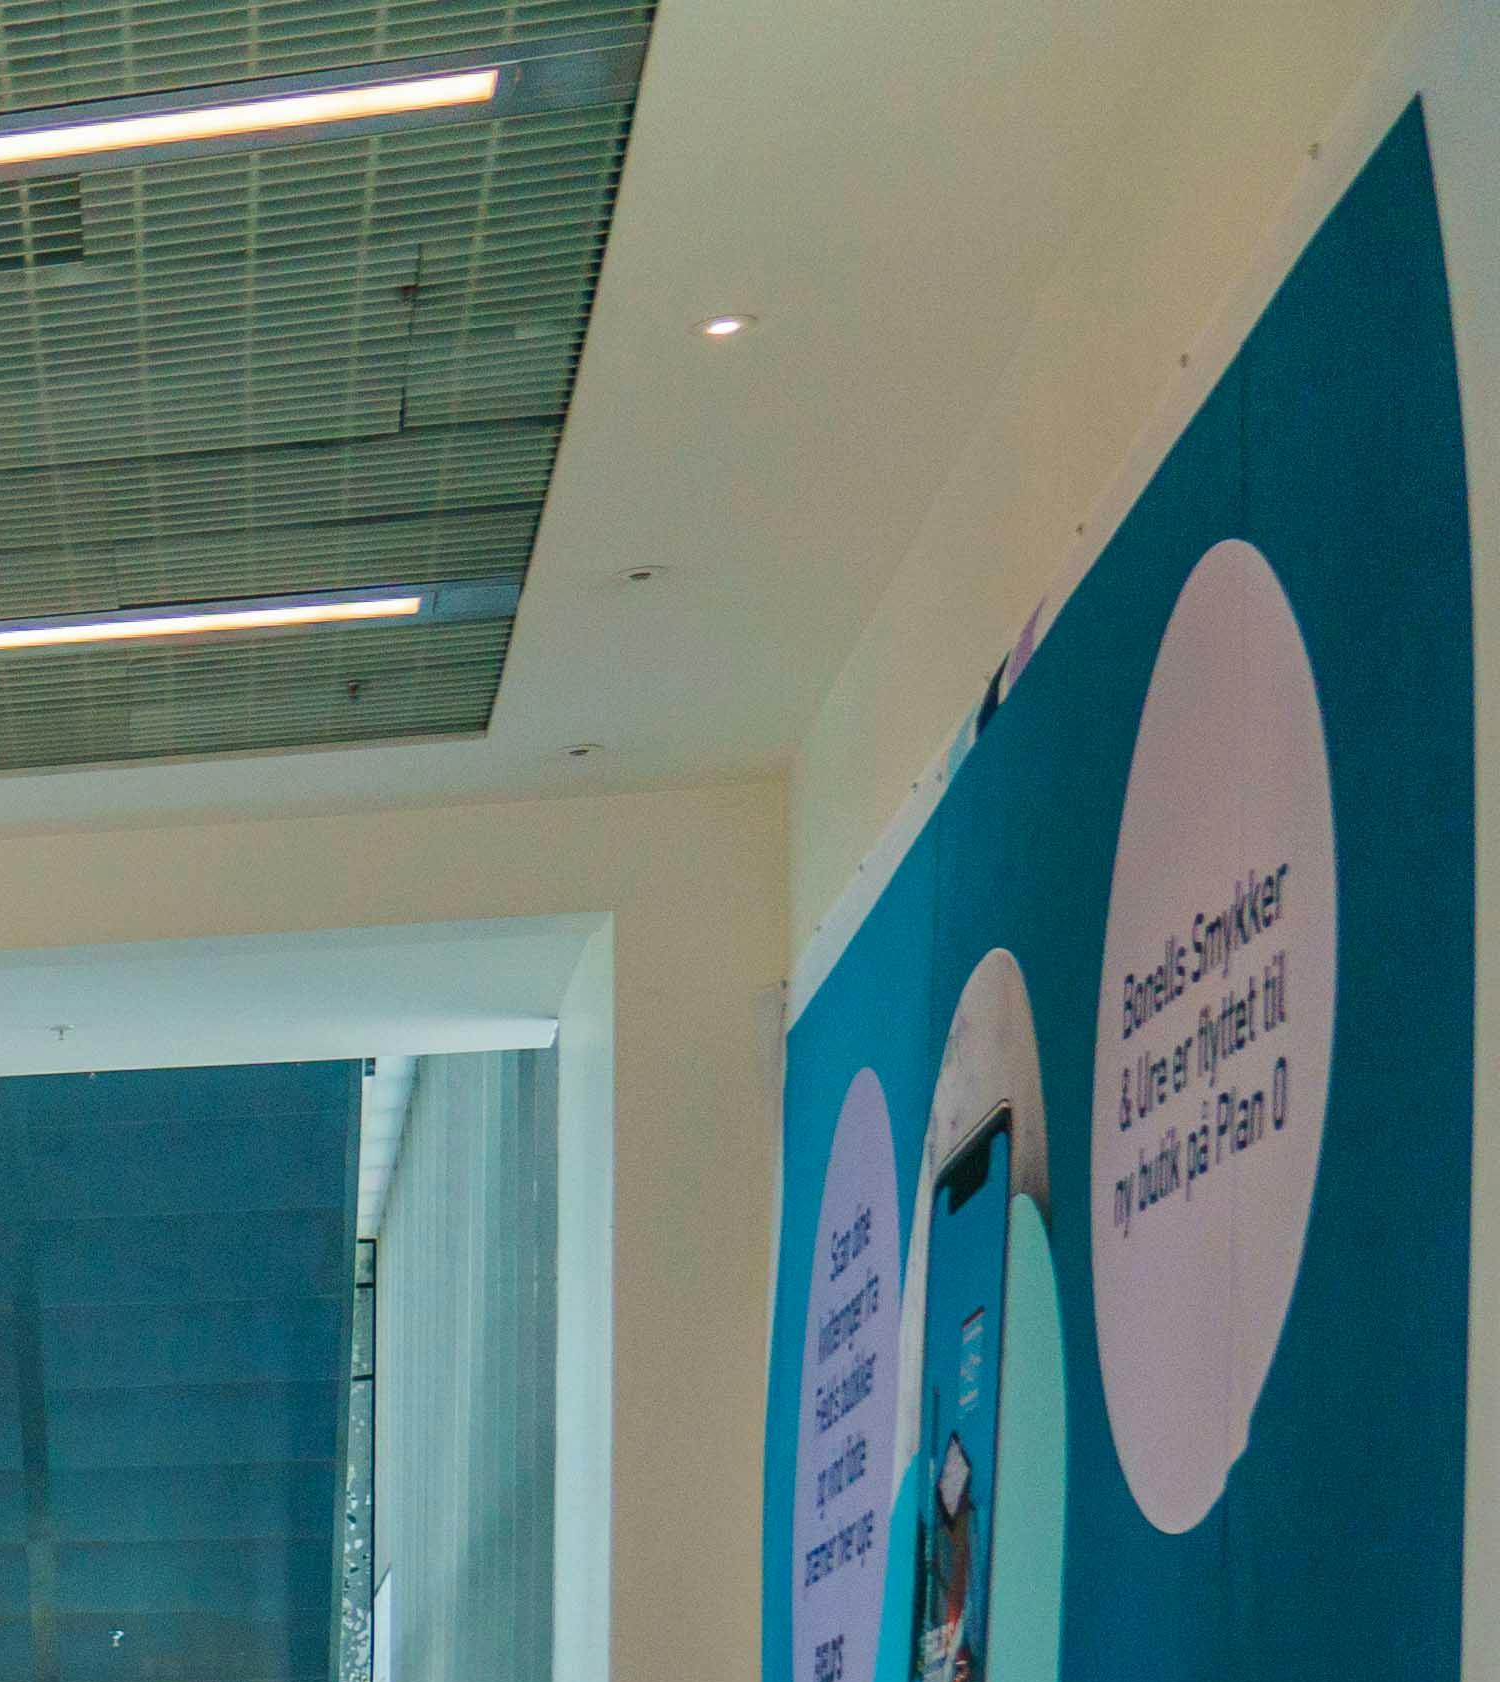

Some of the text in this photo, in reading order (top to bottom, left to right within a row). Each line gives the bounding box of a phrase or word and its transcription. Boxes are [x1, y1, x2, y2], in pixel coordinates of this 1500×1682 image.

[1190, 862, 1290, 983] Smykker
[1119, 949, 1287, 1132] & Ure er flyttet til
[1114, 1171, 1135, 1240] ny
[1138, 1125, 1182, 1212] butik
[1185, 1099, 1210, 1202] på
[1216, 1086, 1265, 1165] Plan
